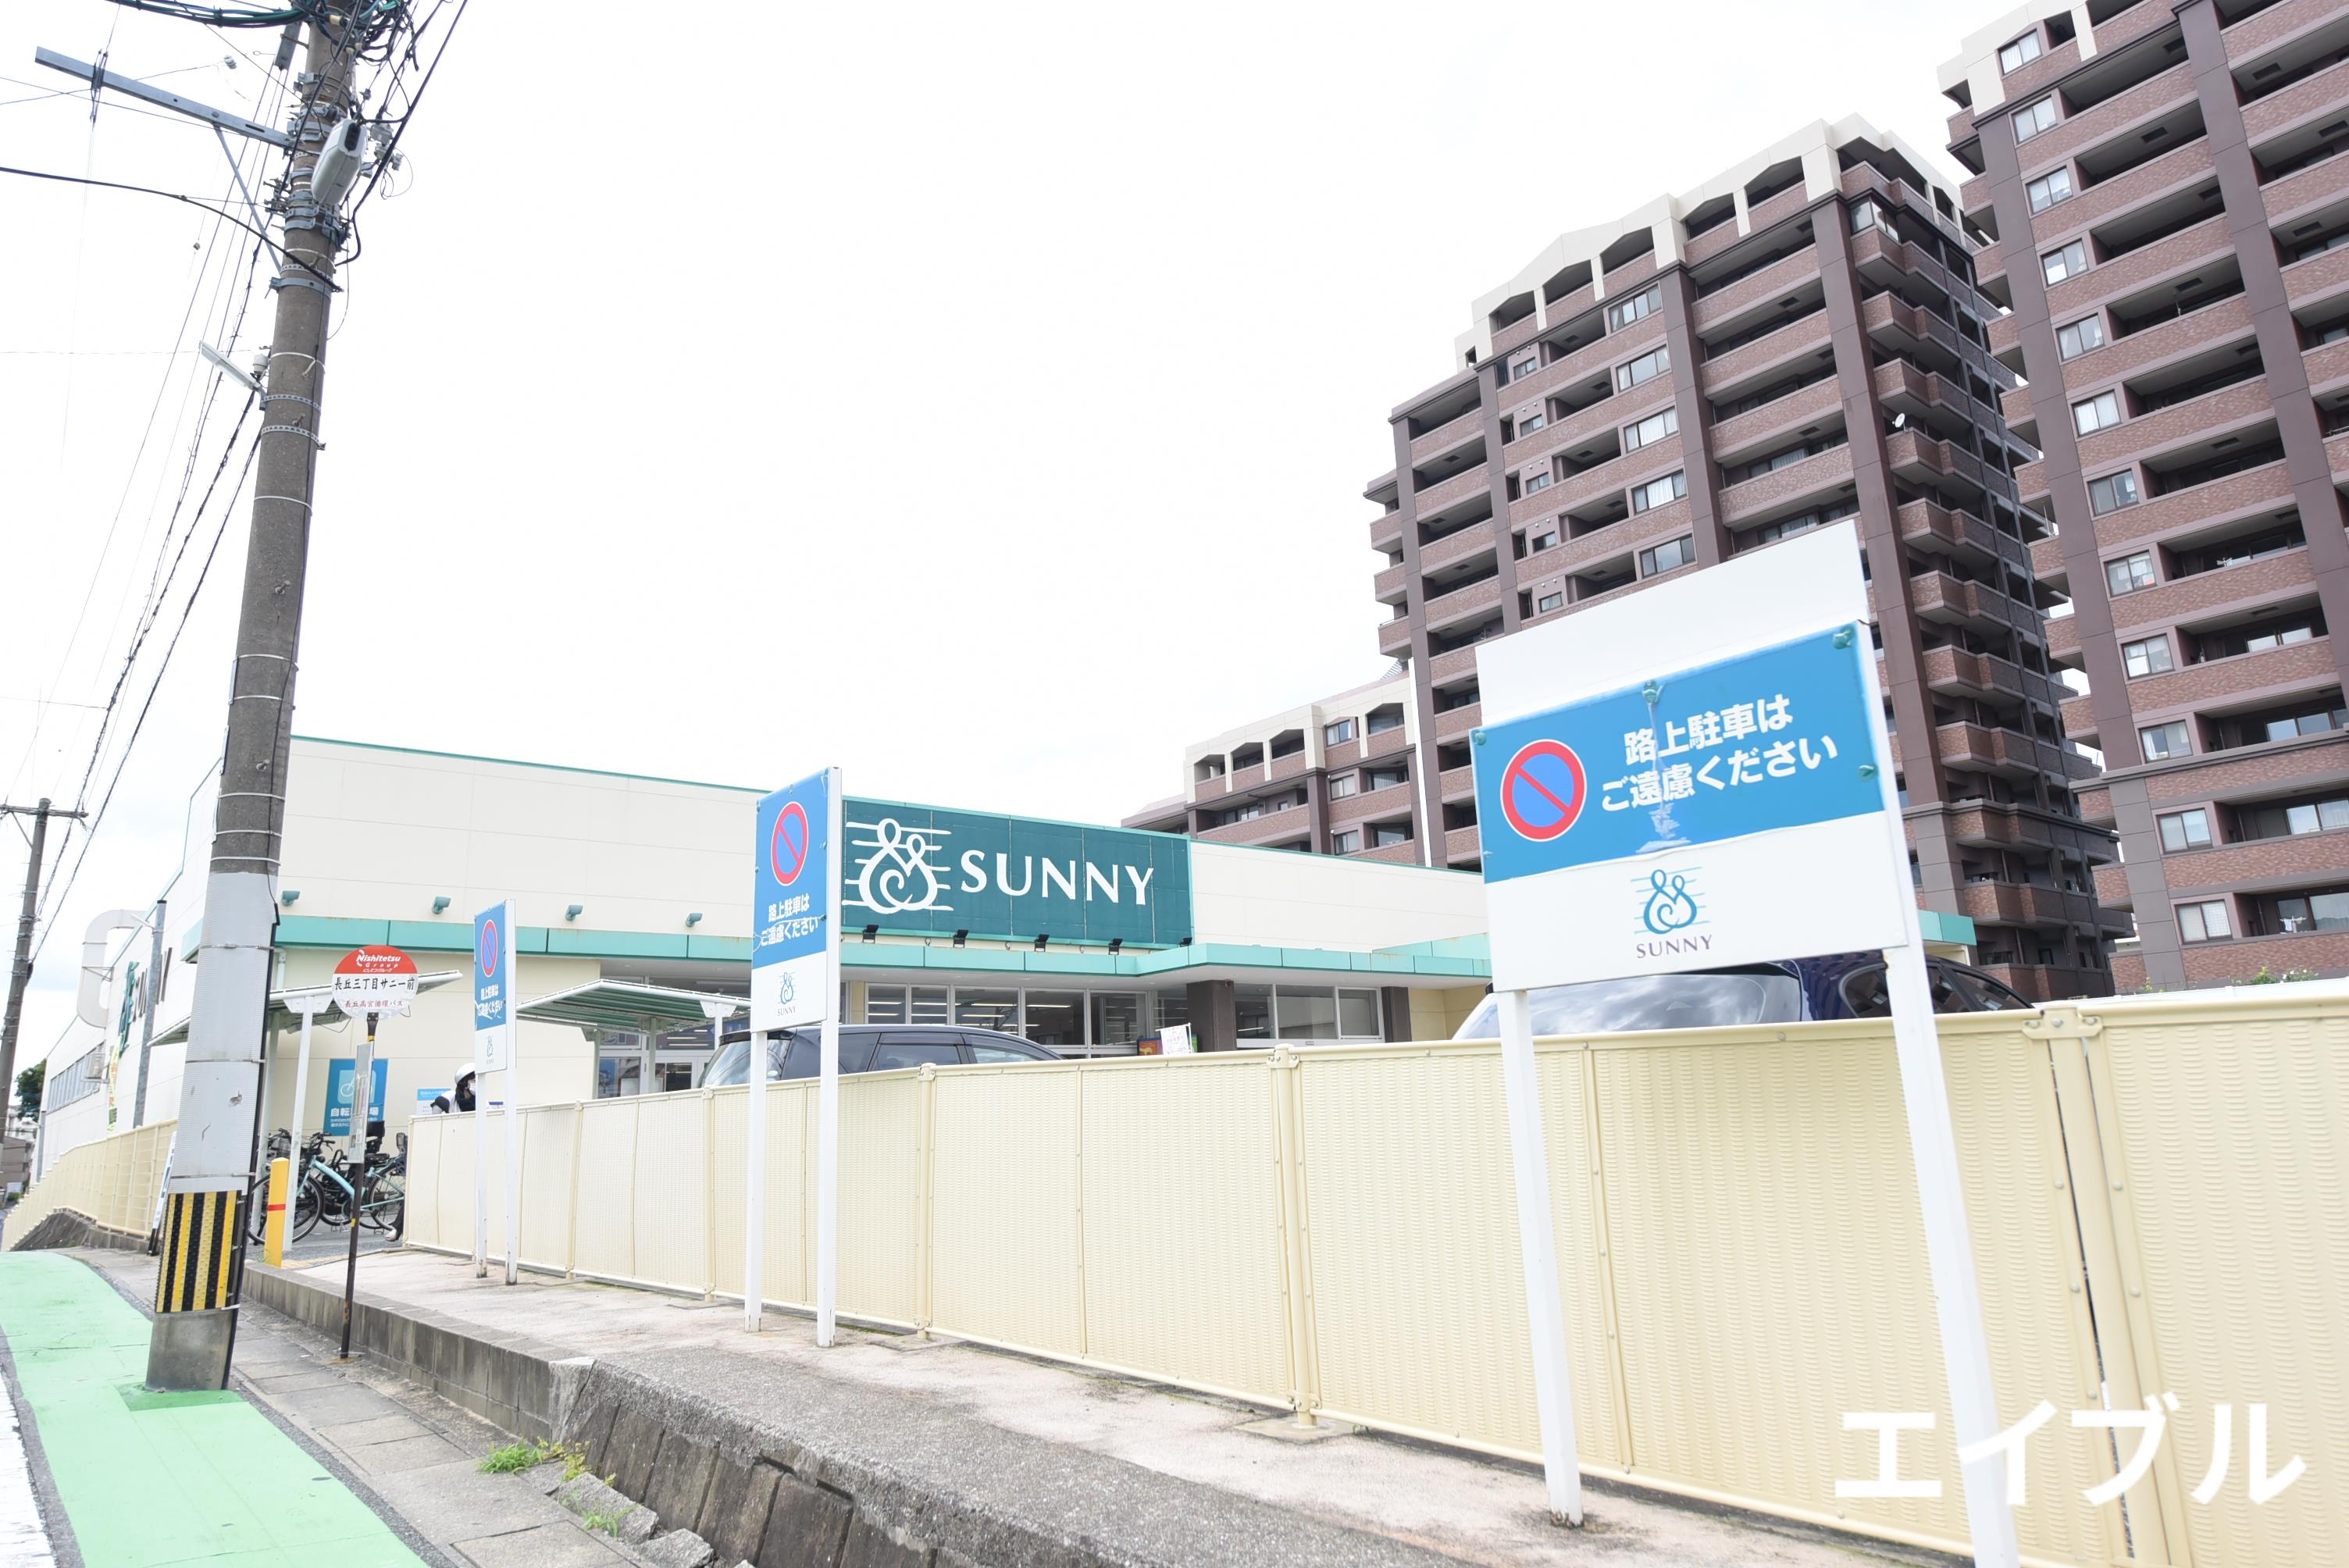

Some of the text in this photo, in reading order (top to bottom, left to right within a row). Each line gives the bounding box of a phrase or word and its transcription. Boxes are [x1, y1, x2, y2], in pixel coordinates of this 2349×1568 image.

[1624, 693, 1793, 765] 路上駐車は
[1602, 736, 1837, 811] ご遠慮ください
[961, 850, 1154, 906] SUNNY
[768, 893, 810, 922] 路上駐車は
[761, 917, 818, 946] ご遠慮ください
[1636, 934, 1712, 958] SUNNY
[356, 950, 401, 964] Nishitetsu
[334, 977, 415, 991] 長丘三丁目サニー前
[777, 1005, 797, 1017] SUNNY
